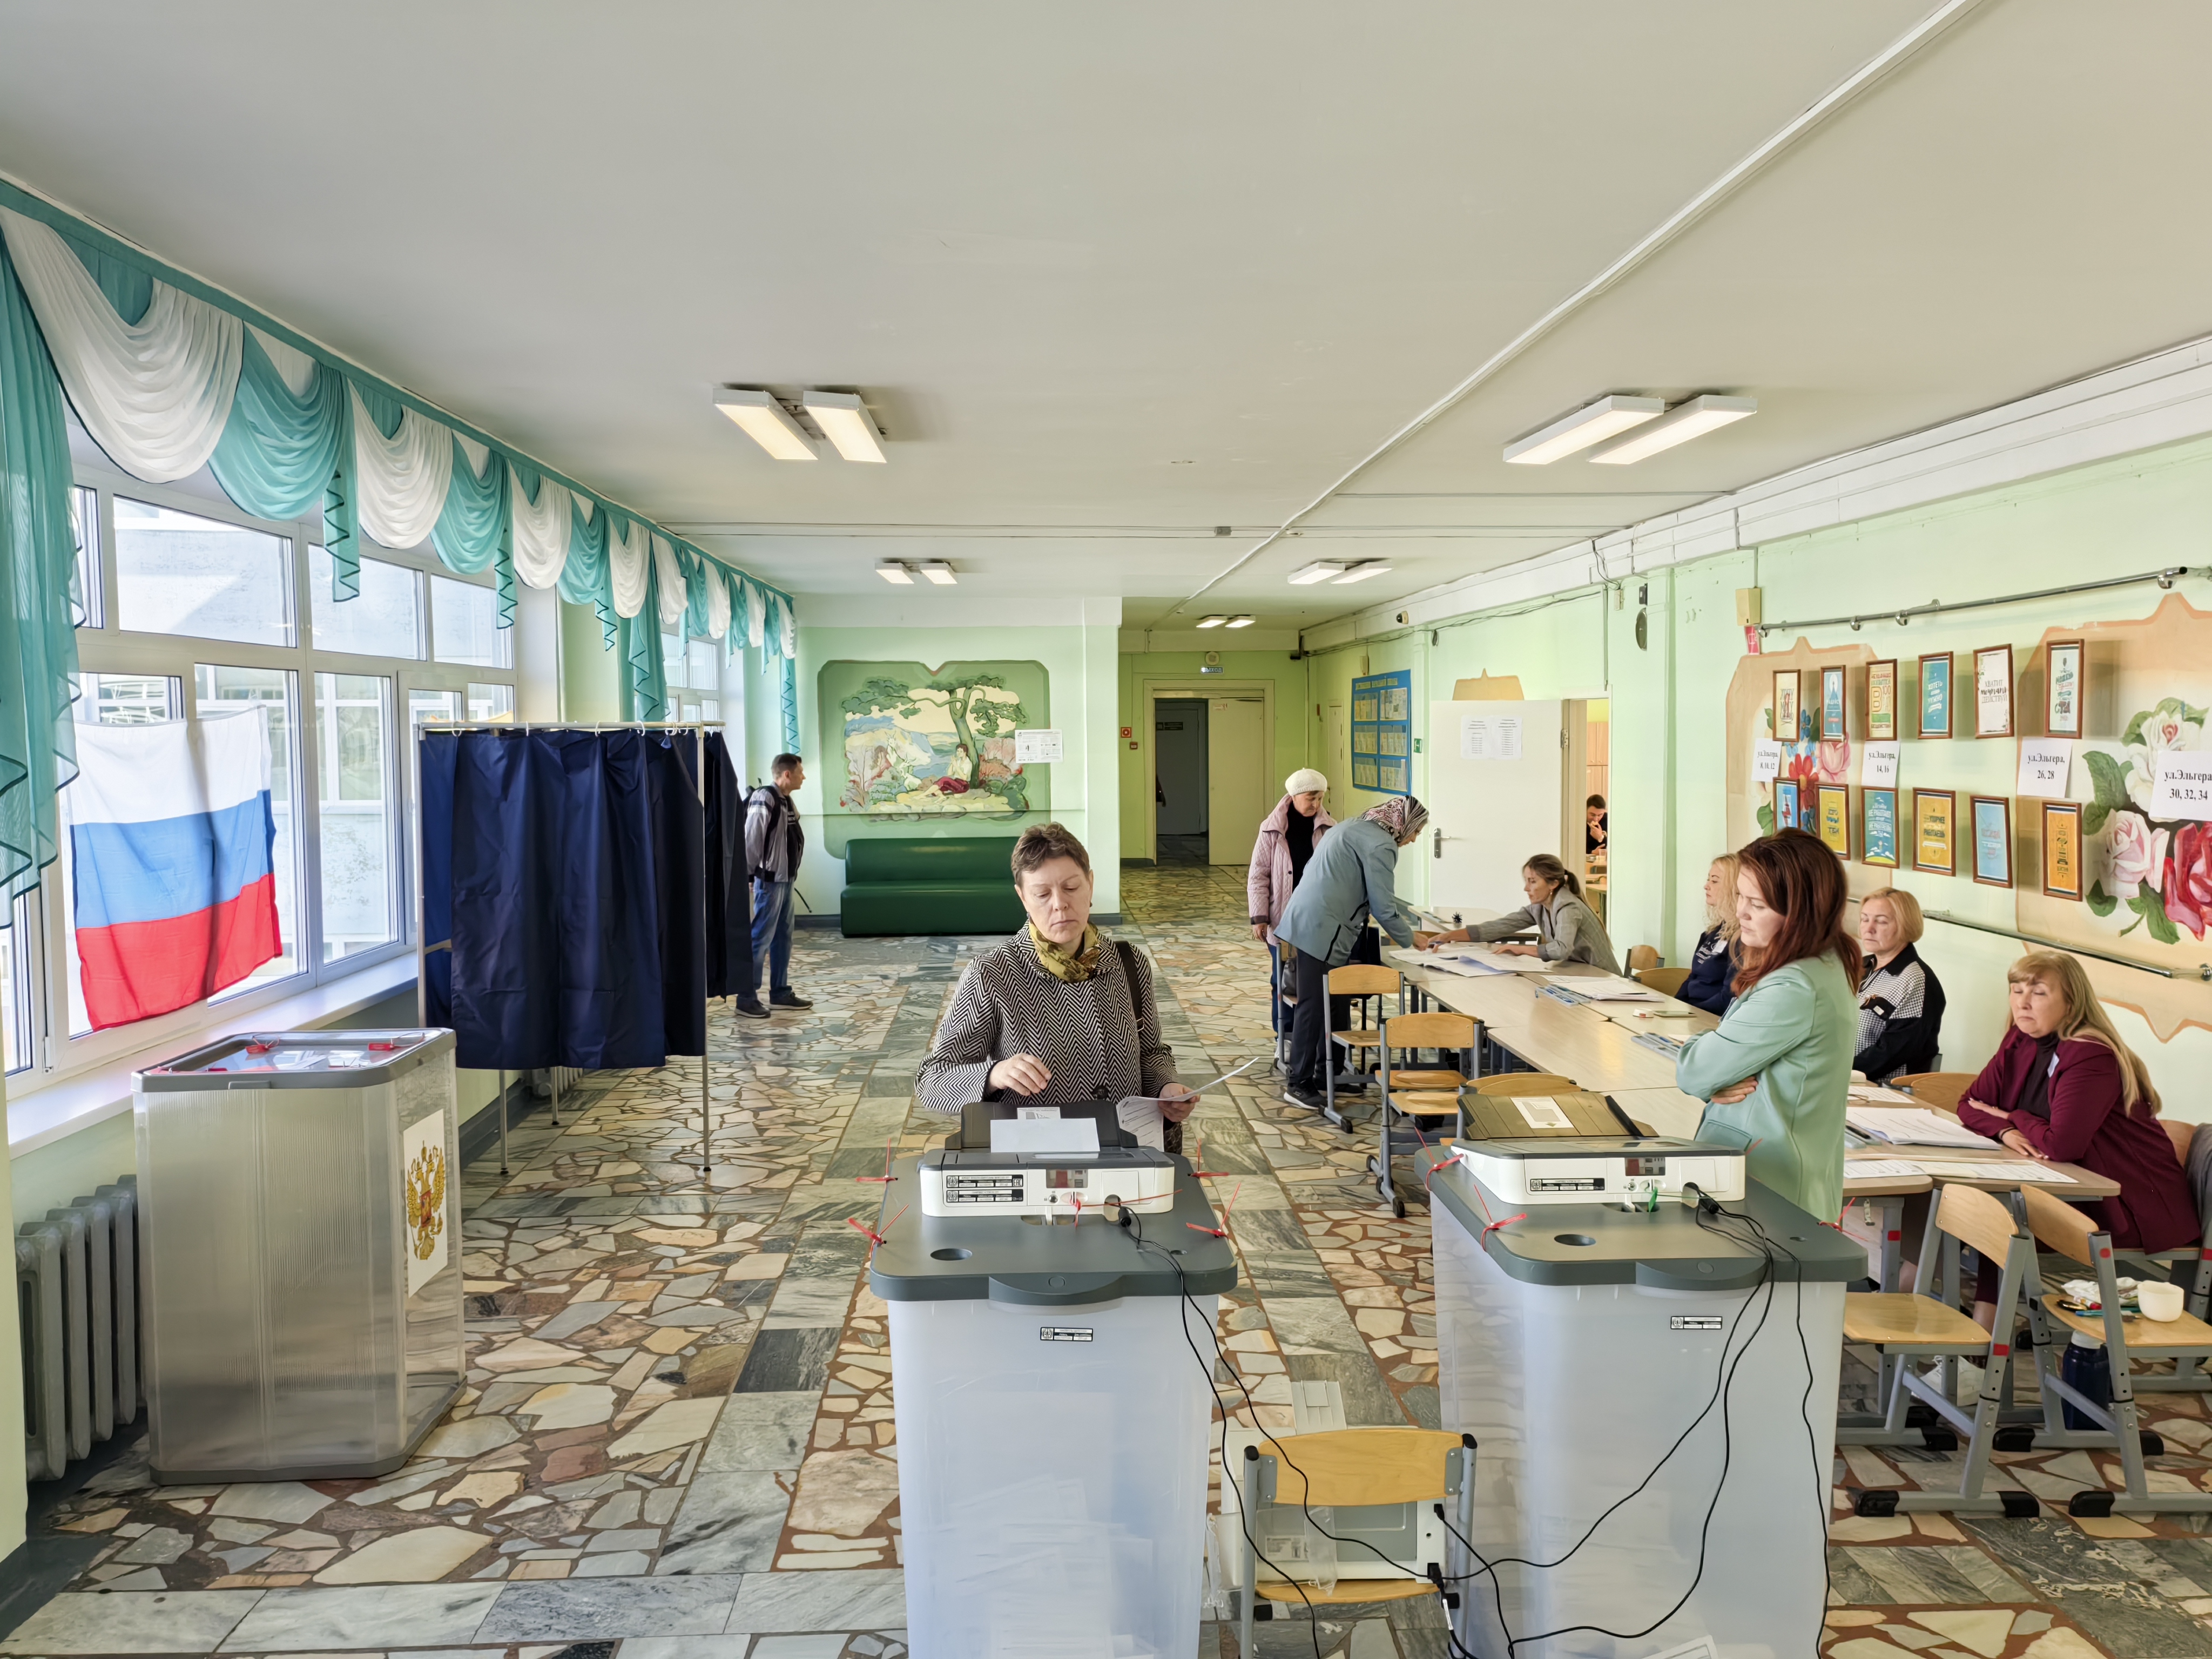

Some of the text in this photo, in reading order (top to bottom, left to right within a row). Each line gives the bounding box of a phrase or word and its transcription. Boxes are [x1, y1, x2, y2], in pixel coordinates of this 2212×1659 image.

[1871, 686, 1882, 712] В
[2027, 753, 2065, 764] ул.Эльгера,
[2038, 770, 2054, 780] 26, 28
[2169, 788, 2208, 801] 30, 32, 34
